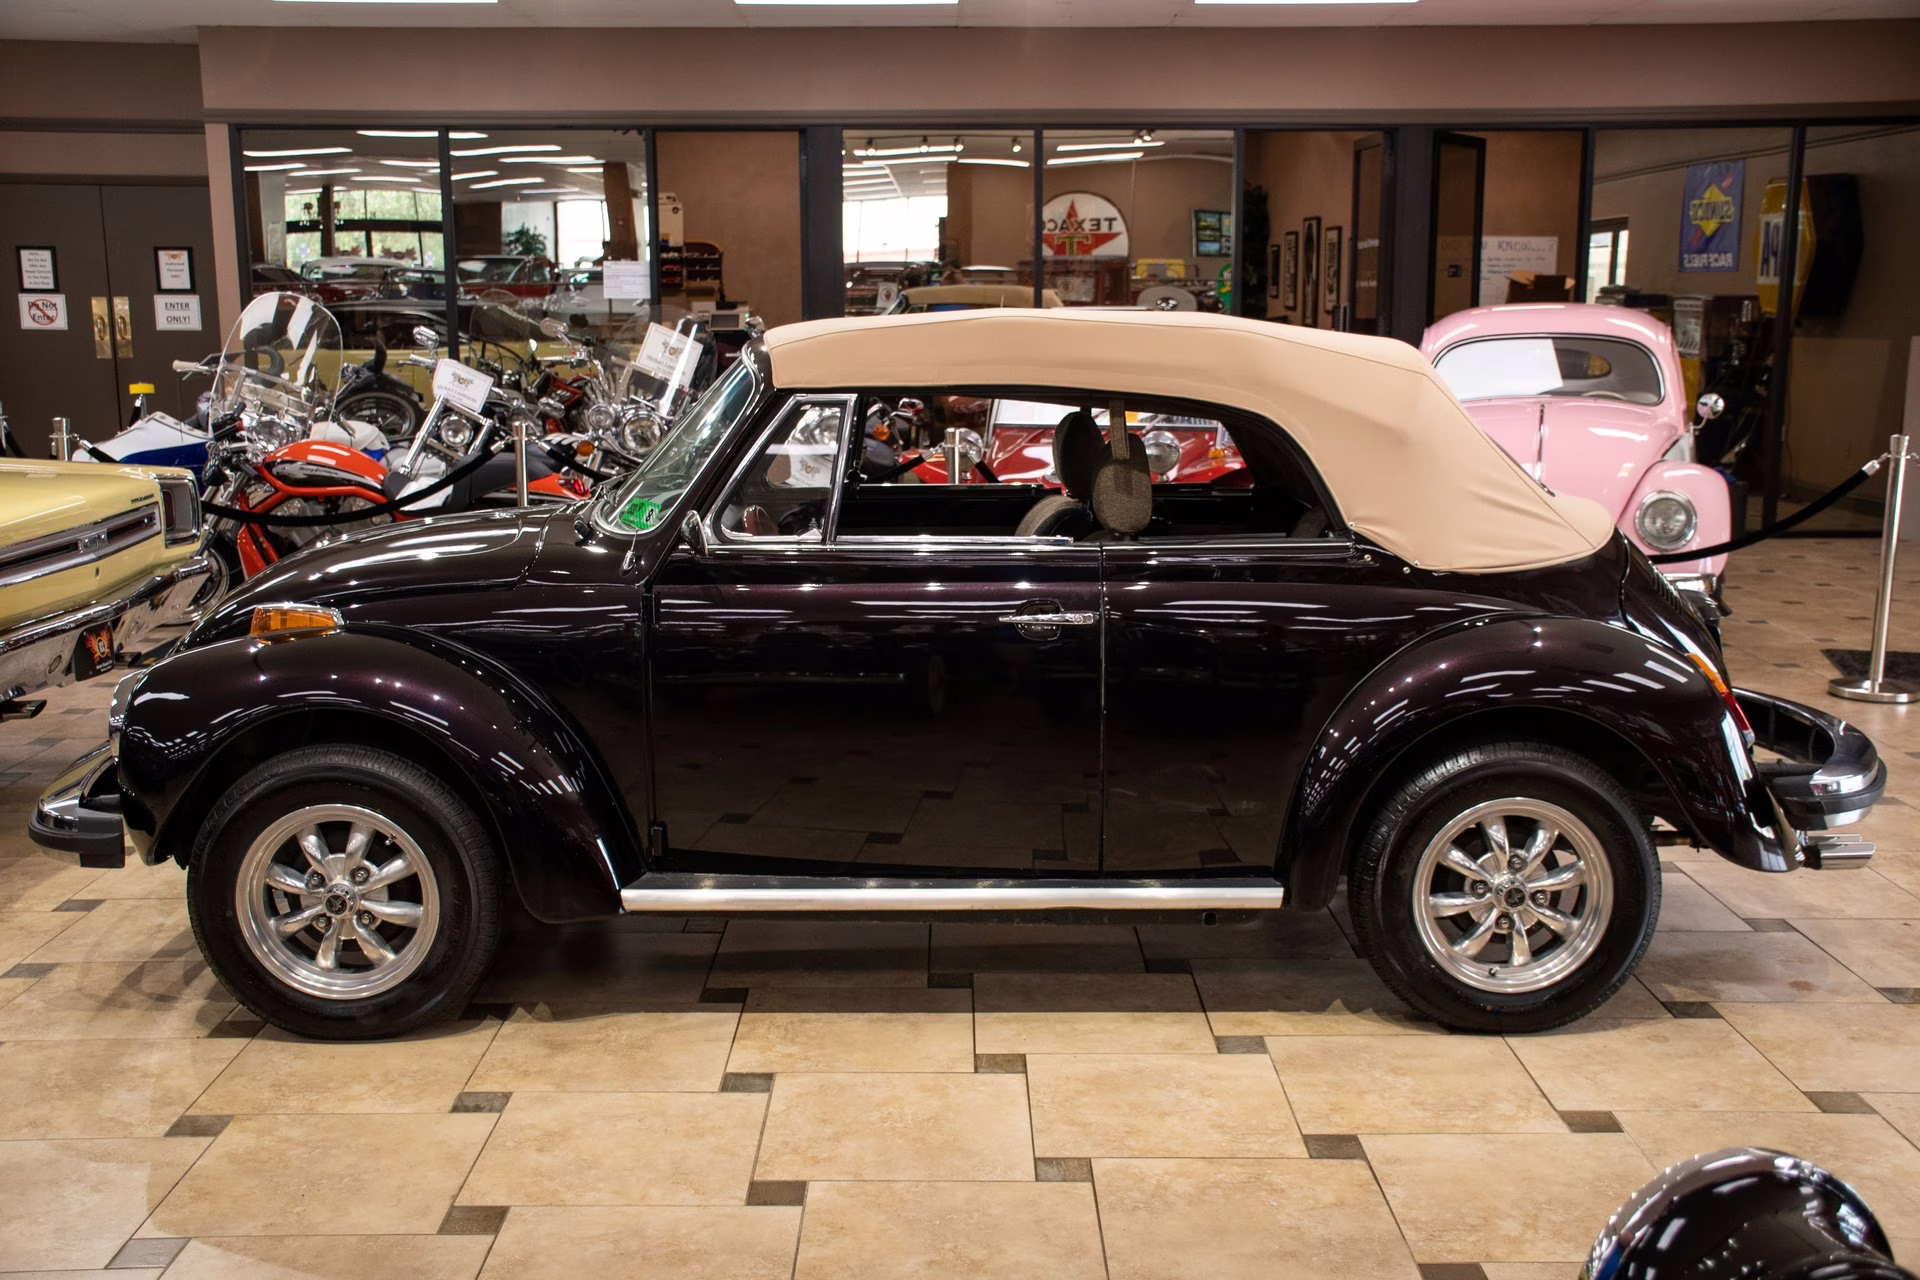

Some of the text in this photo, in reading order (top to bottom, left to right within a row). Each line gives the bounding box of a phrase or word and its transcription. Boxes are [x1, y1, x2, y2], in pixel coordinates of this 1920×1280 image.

[165, 302, 190, 310] ENTER
[32, 313, 54, 321] Enter
[166, 315, 191, 324] ONLY!
